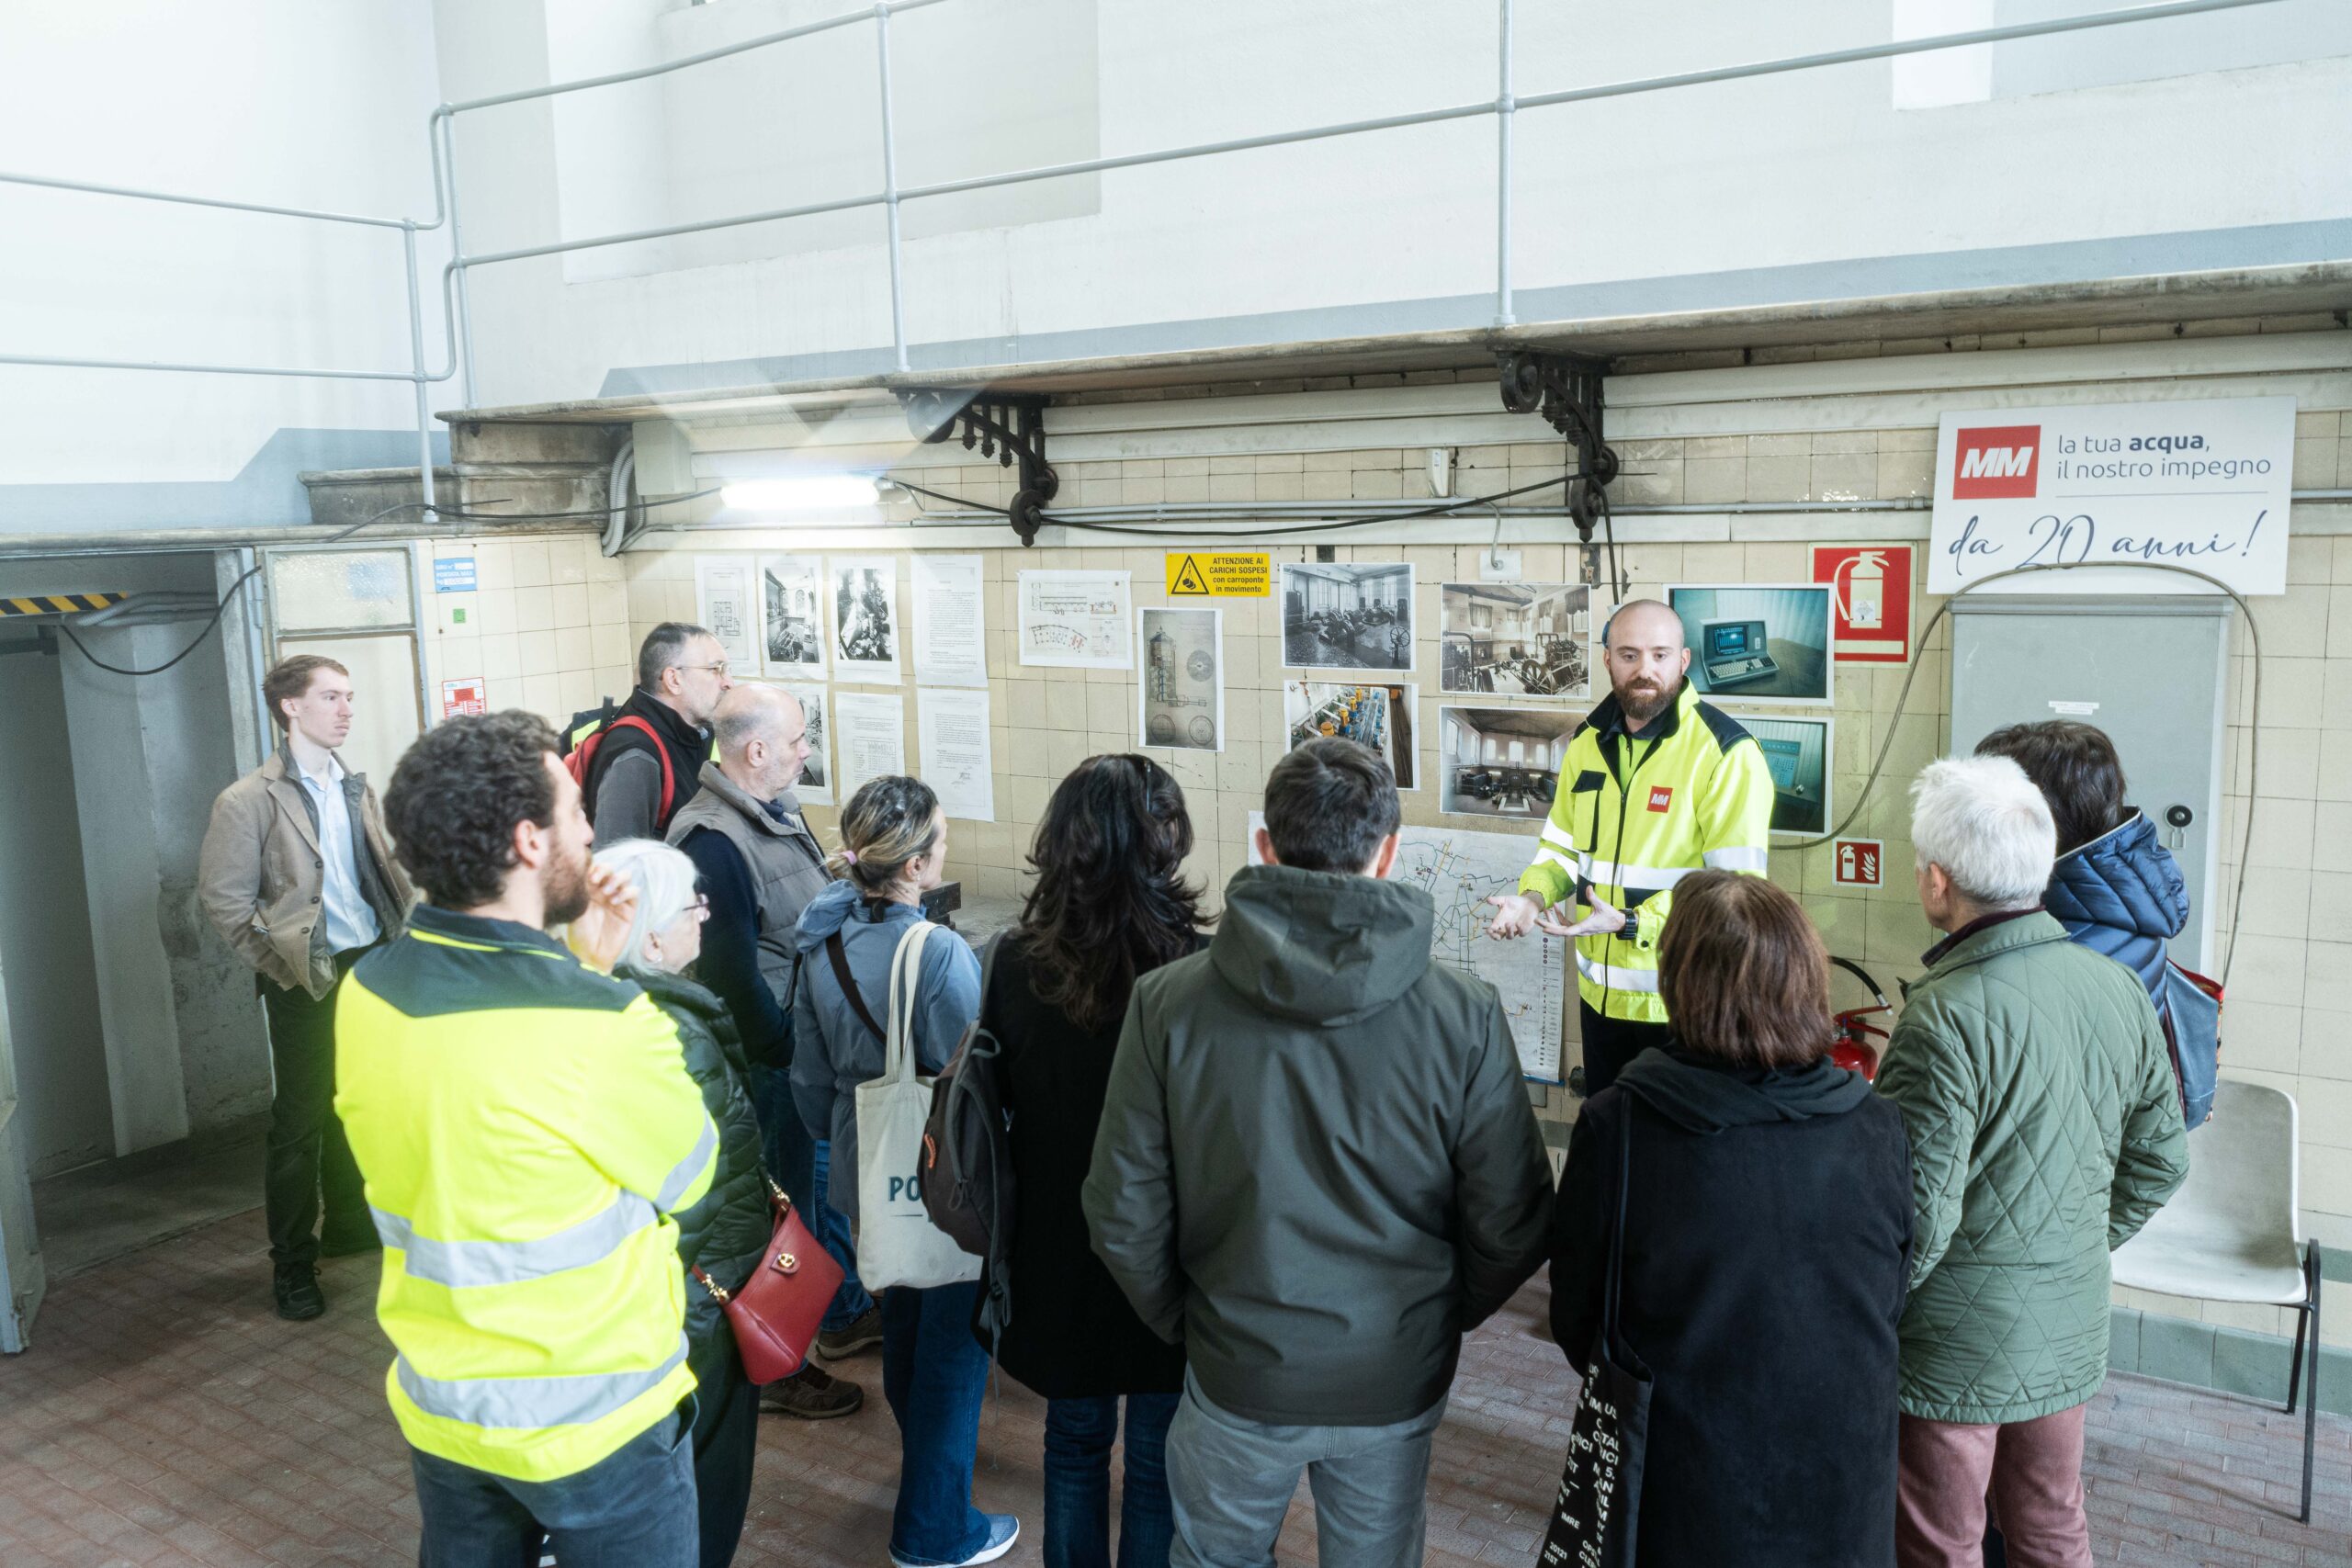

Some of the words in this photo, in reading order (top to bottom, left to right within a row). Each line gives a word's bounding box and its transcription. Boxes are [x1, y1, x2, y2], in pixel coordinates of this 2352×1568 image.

[2059, 434, 2076, 454] la
[2086, 436, 2121, 452] tua
[2129, 434, 2210, 454] acqua,
[1961, 446, 2033, 479] MM
[2057, 461, 2068, 479] il
[2077, 460, 2153, 478] nostro
[2162, 457, 2271, 480] impegno
[1949, 515, 2004, 576] da
[2015, 514, 2095, 570] 20
[1227, 576, 1264, 584] carroponte
